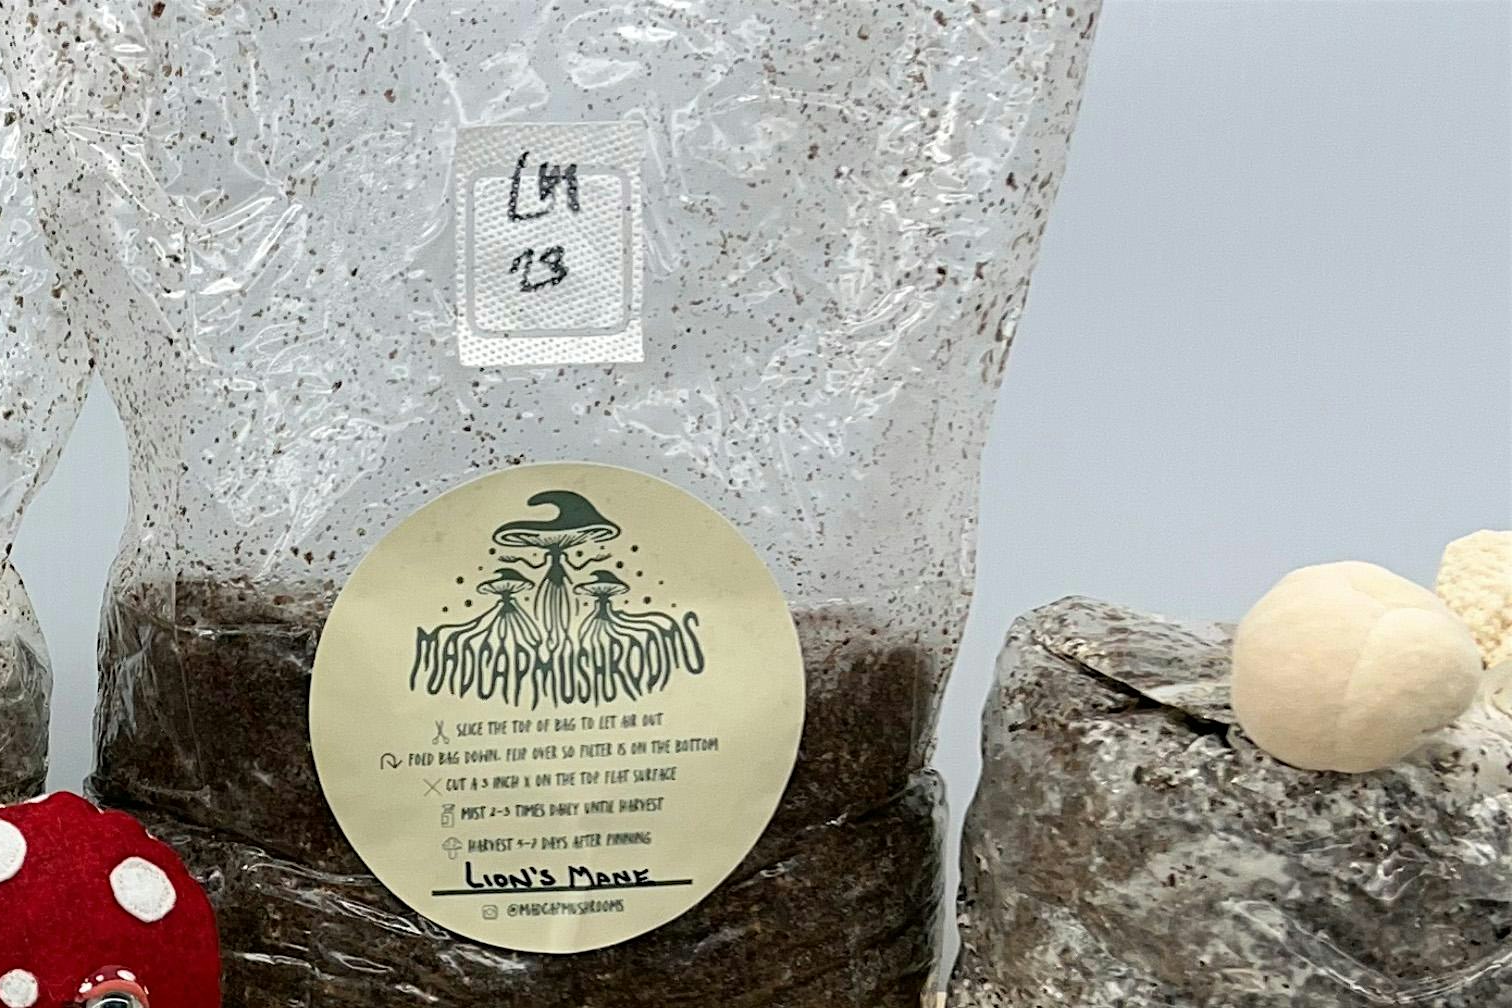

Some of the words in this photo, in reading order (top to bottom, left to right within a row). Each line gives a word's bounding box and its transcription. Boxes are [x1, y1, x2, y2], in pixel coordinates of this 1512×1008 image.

[456, 722, 483, 737] SLICE
[487, 721, 507, 735] THE
[512, 720, 532, 733] TOP
[537, 719, 549, 732] OF
[554, 718, 575, 731] BAG
[581, 717, 594, 730] TO
[599, 715, 617, 729] LET
[621, 714, 636, 728] AIR
[642, 713, 664, 727] OUT
[408, 753, 434, 766] FOLD
[439, 752, 459, 765] BAG
[506, 748, 528, 762] FLIP
[532, 746, 557, 760] OVER
[562, 745, 575, 759] SO
[617, 743, 626, 755] IS
[631, 742, 647, 755] ON
[651, 739, 670, 753] THE
[675, 737, 718, 753] BOTTOM
[446, 778, 467, 791] CUT
[470, 778, 478, 790] A
[556, 772, 575, 786] THE
[580, 771, 599, 784] TOP
[633, 767, 677, 783] SURFACE
[468, 838, 513, 852] HARVEST
[572, 833, 601, 848] AFTER
